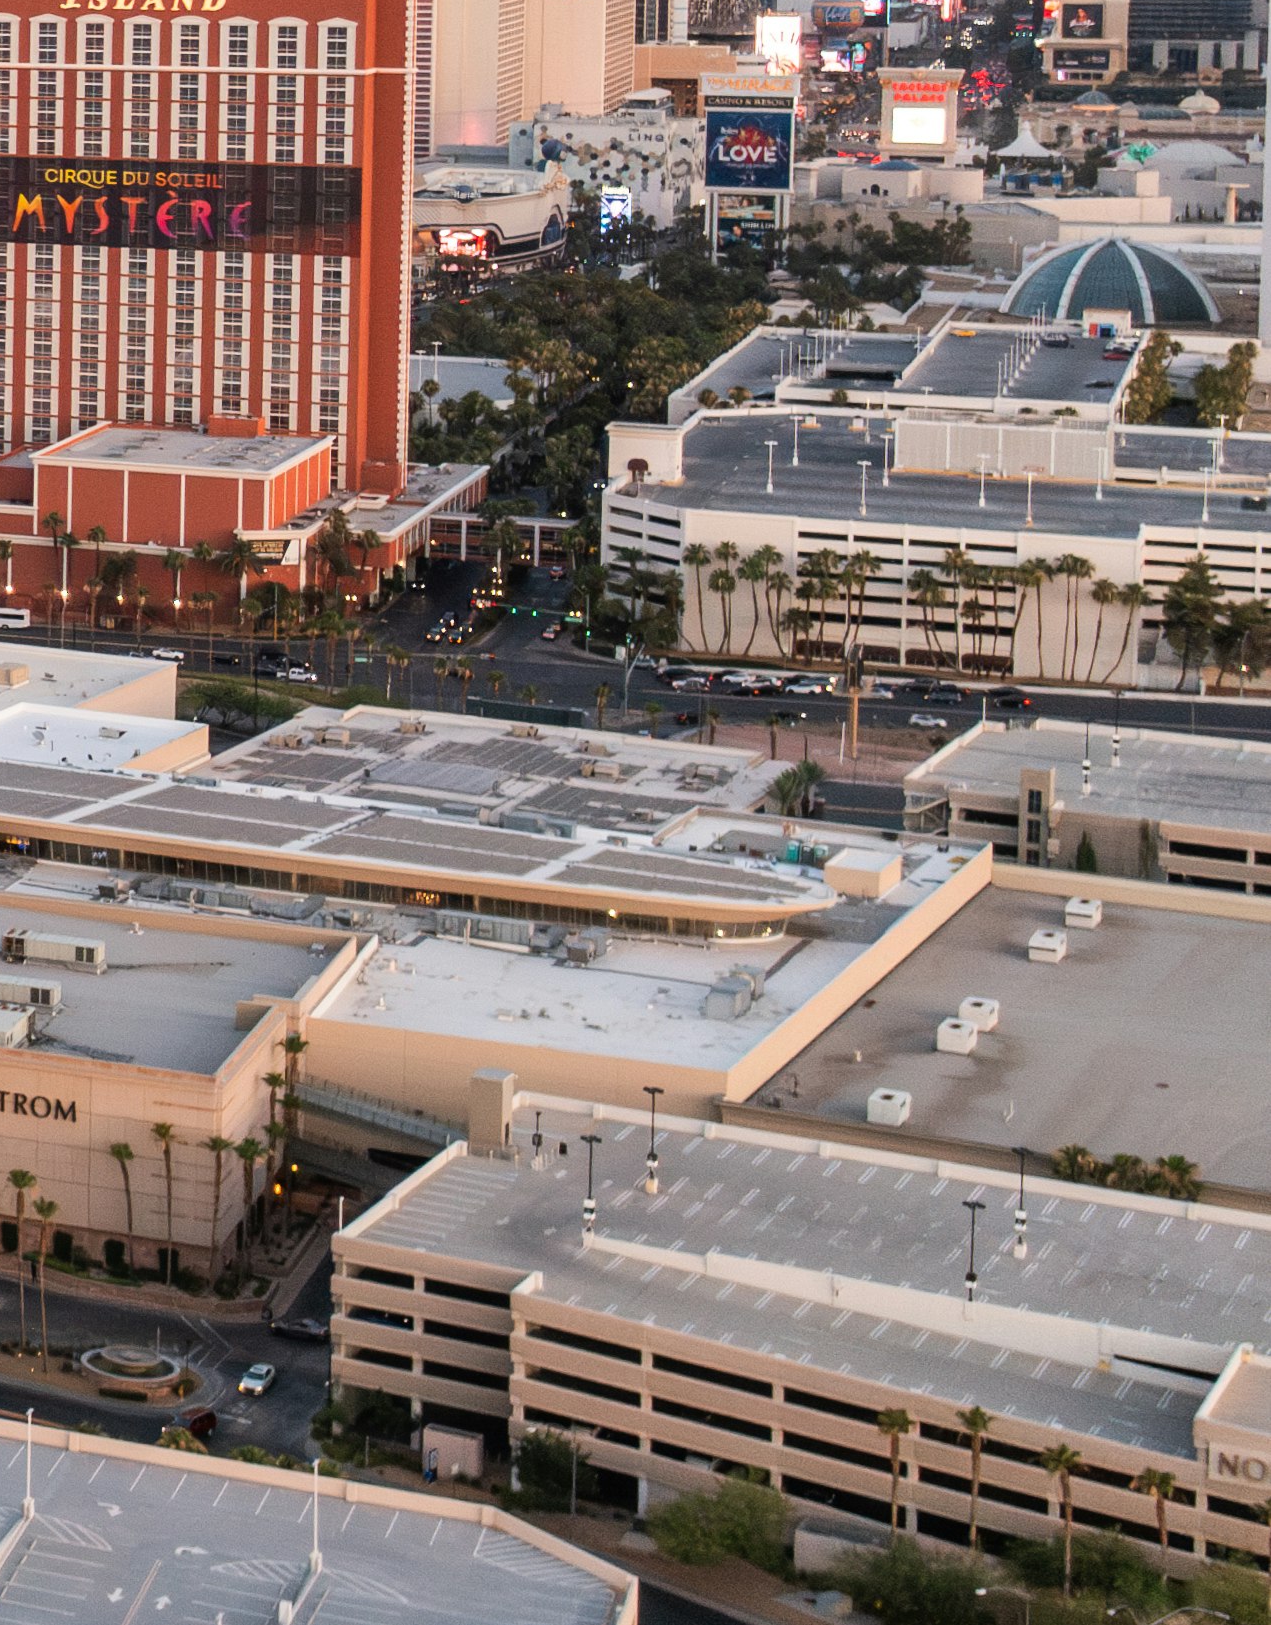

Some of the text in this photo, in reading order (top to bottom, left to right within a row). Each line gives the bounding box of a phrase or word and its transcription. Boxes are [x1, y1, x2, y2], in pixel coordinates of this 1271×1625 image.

[718, 143, 777, 163] LOVE
[45, 169, 222, 188] CIRQUE DU SOLEIL
[12, 190, 252, 240] MYSTÈRE
